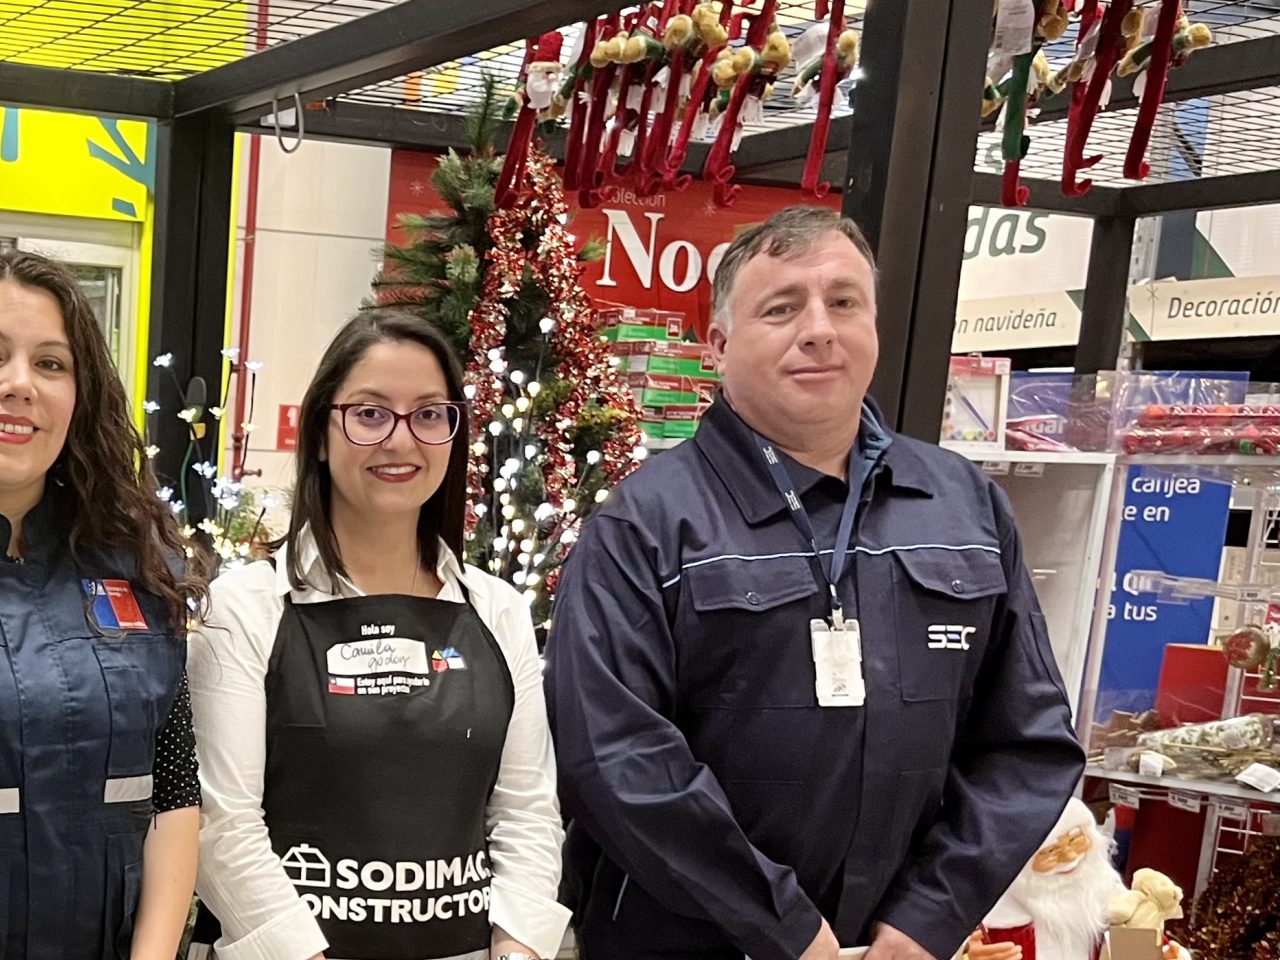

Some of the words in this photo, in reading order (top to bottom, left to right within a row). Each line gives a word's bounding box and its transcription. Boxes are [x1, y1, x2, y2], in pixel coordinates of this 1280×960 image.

[973, 307, 1058, 333] navideña
[1143, 505, 1170, 522] en
[1124, 601, 1158, 621] tus
[361, 624, 380, 636] Hola
[381, 624, 395, 636] soy
[927, 624, 977, 651] SEC
[336, 851, 491, 892] SODIMAC
